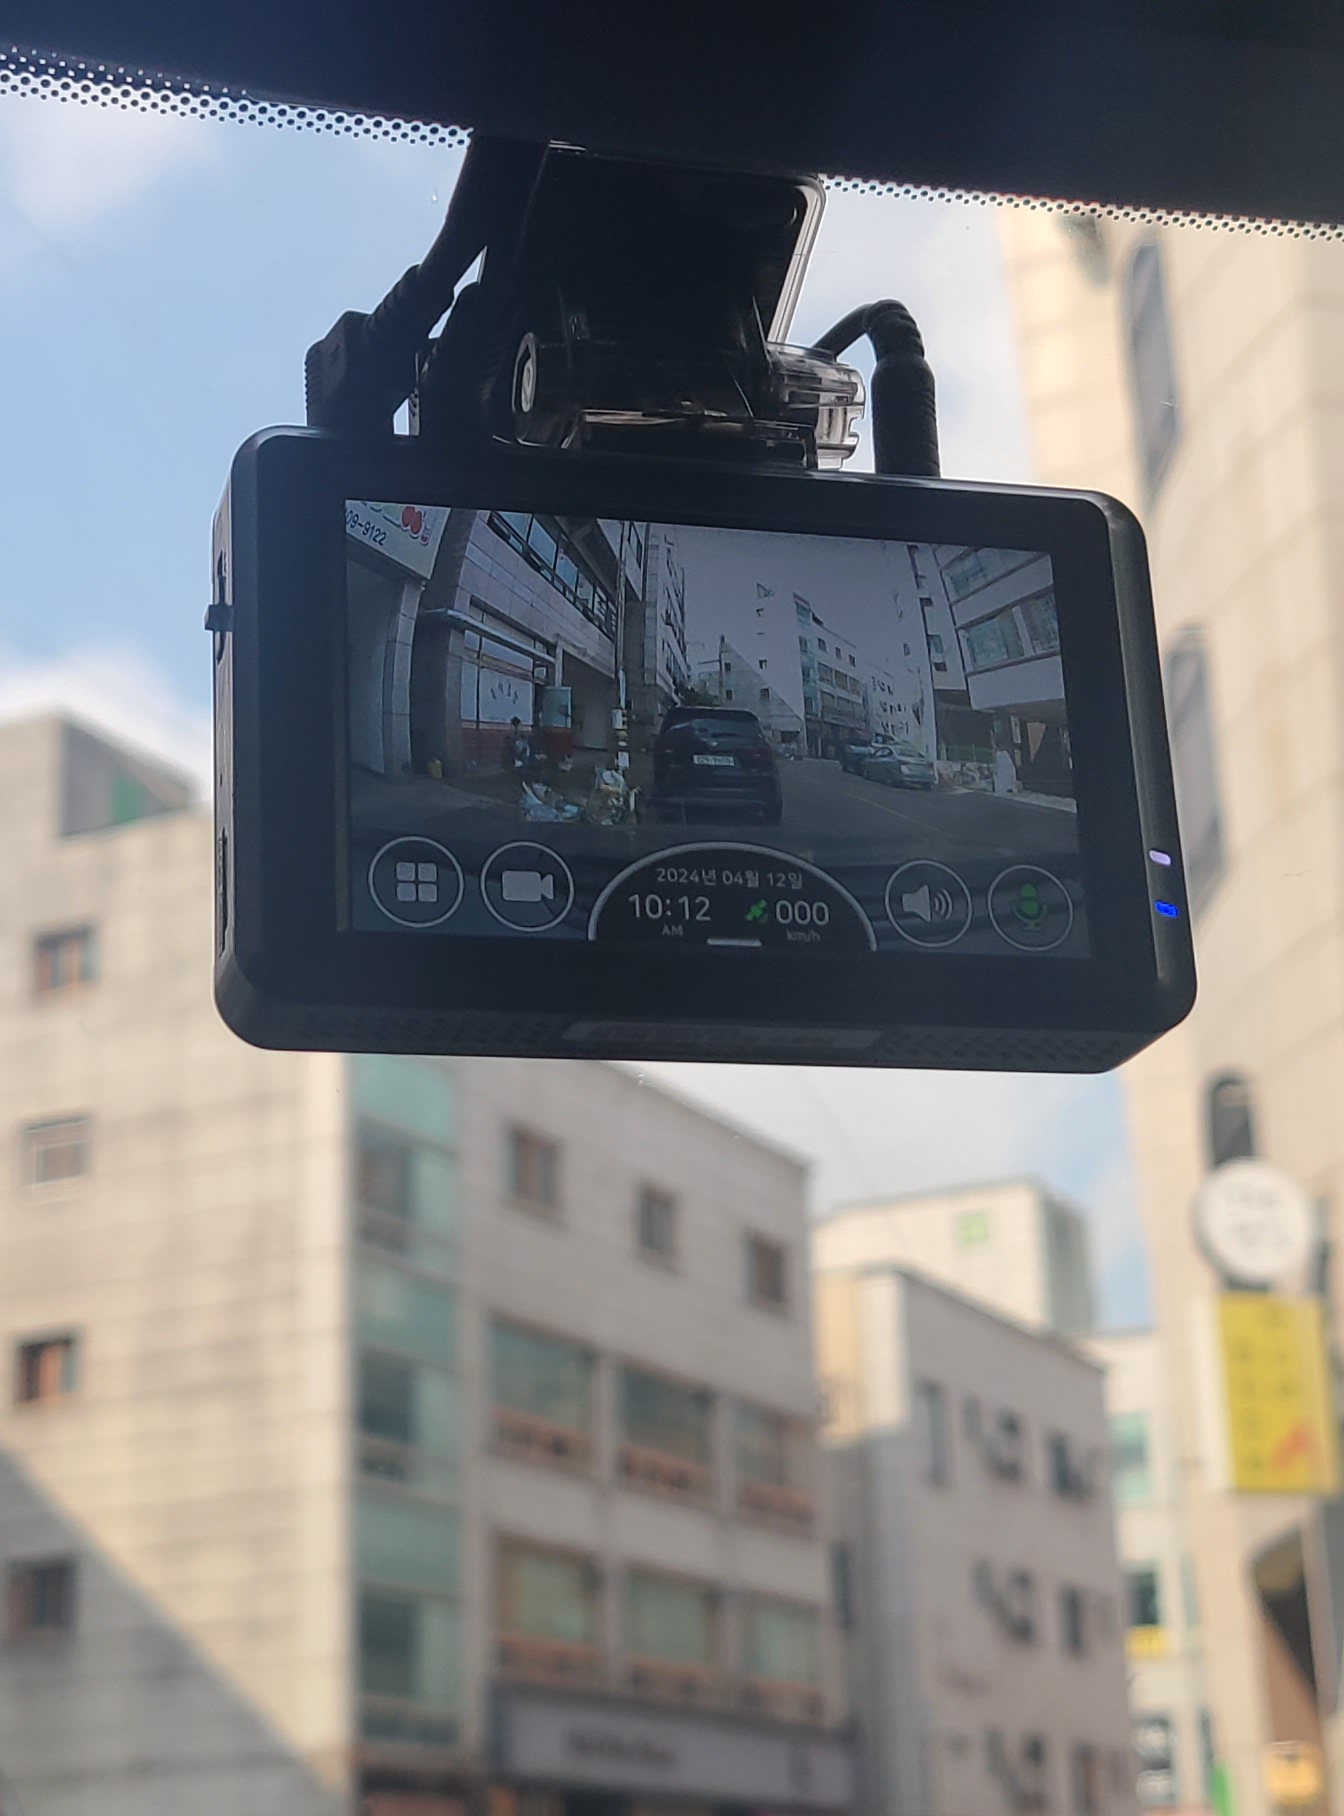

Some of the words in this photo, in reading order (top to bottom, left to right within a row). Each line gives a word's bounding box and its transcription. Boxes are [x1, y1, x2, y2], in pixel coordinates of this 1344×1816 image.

[657, 867, 716, 886] 2024년
[722, 869, 759, 888] 04월
[767, 872, 803, 889] 12일
[629, 894, 711, 921] 10:12
[775, 900, 829, 925] 000
[661, 924, 684, 936] AM
[786, 929, 821, 942] km/h
